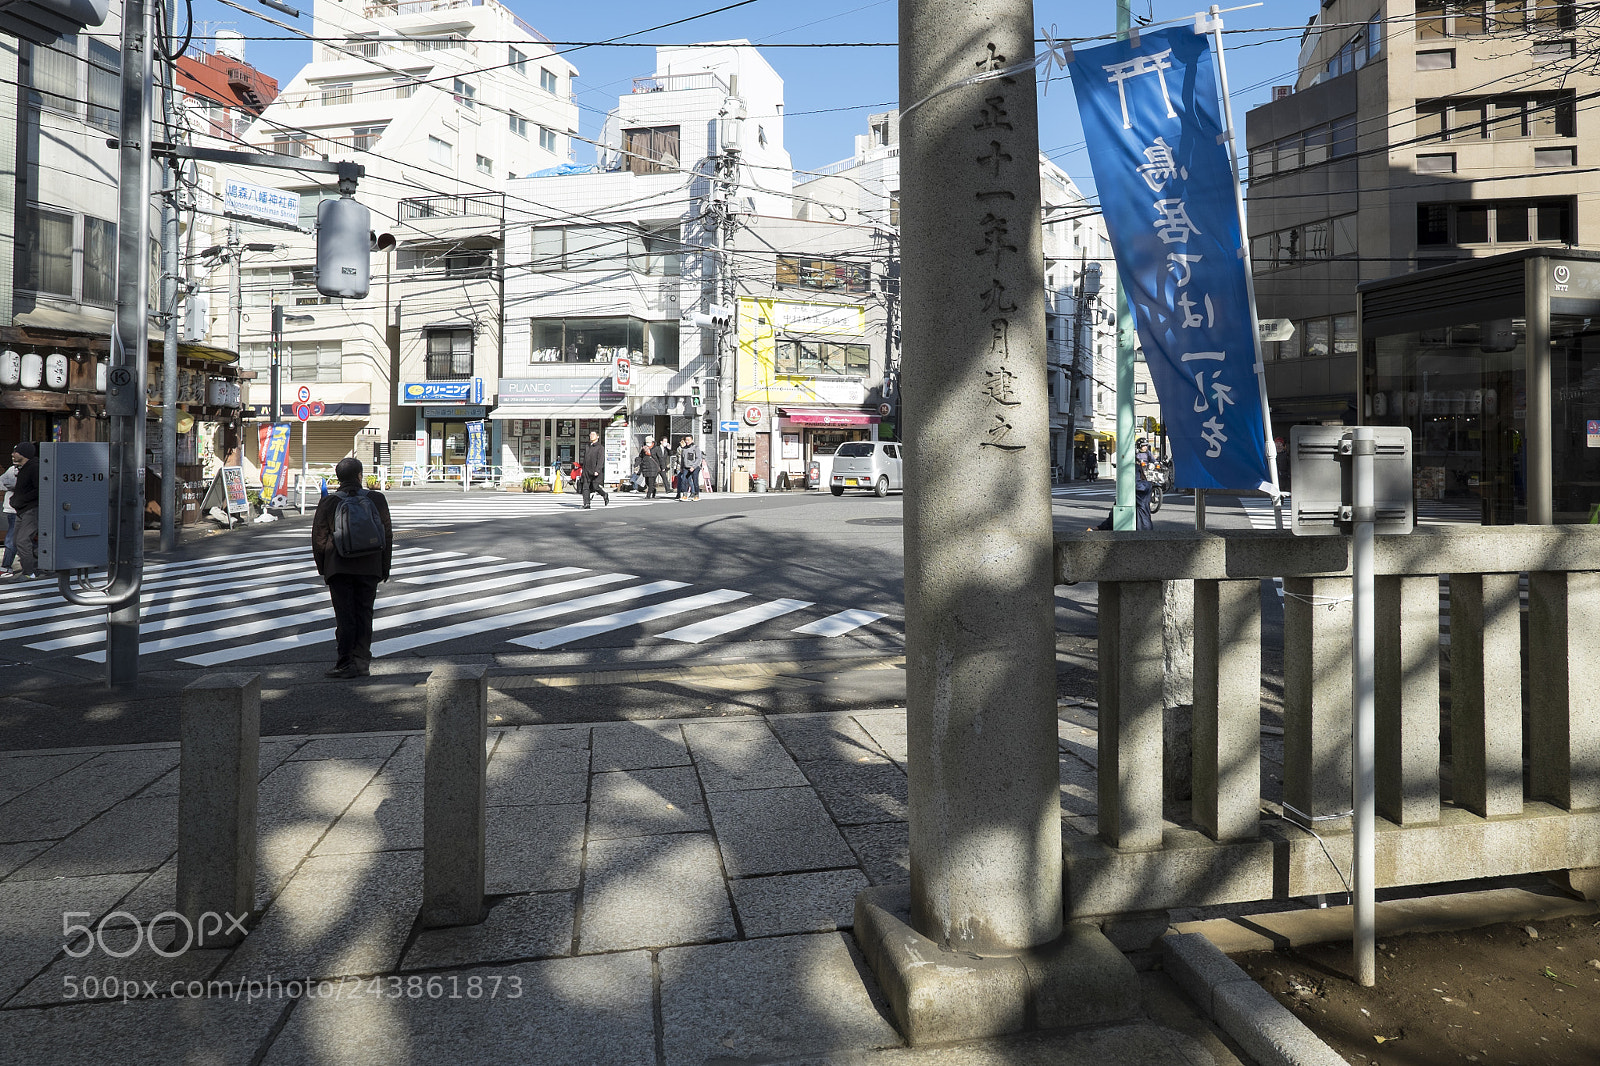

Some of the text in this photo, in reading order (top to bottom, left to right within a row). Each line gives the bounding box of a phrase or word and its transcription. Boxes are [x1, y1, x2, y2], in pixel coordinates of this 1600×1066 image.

[425, 384, 470, 395] クリーニング
[508, 383, 552, 393] PLANEC
